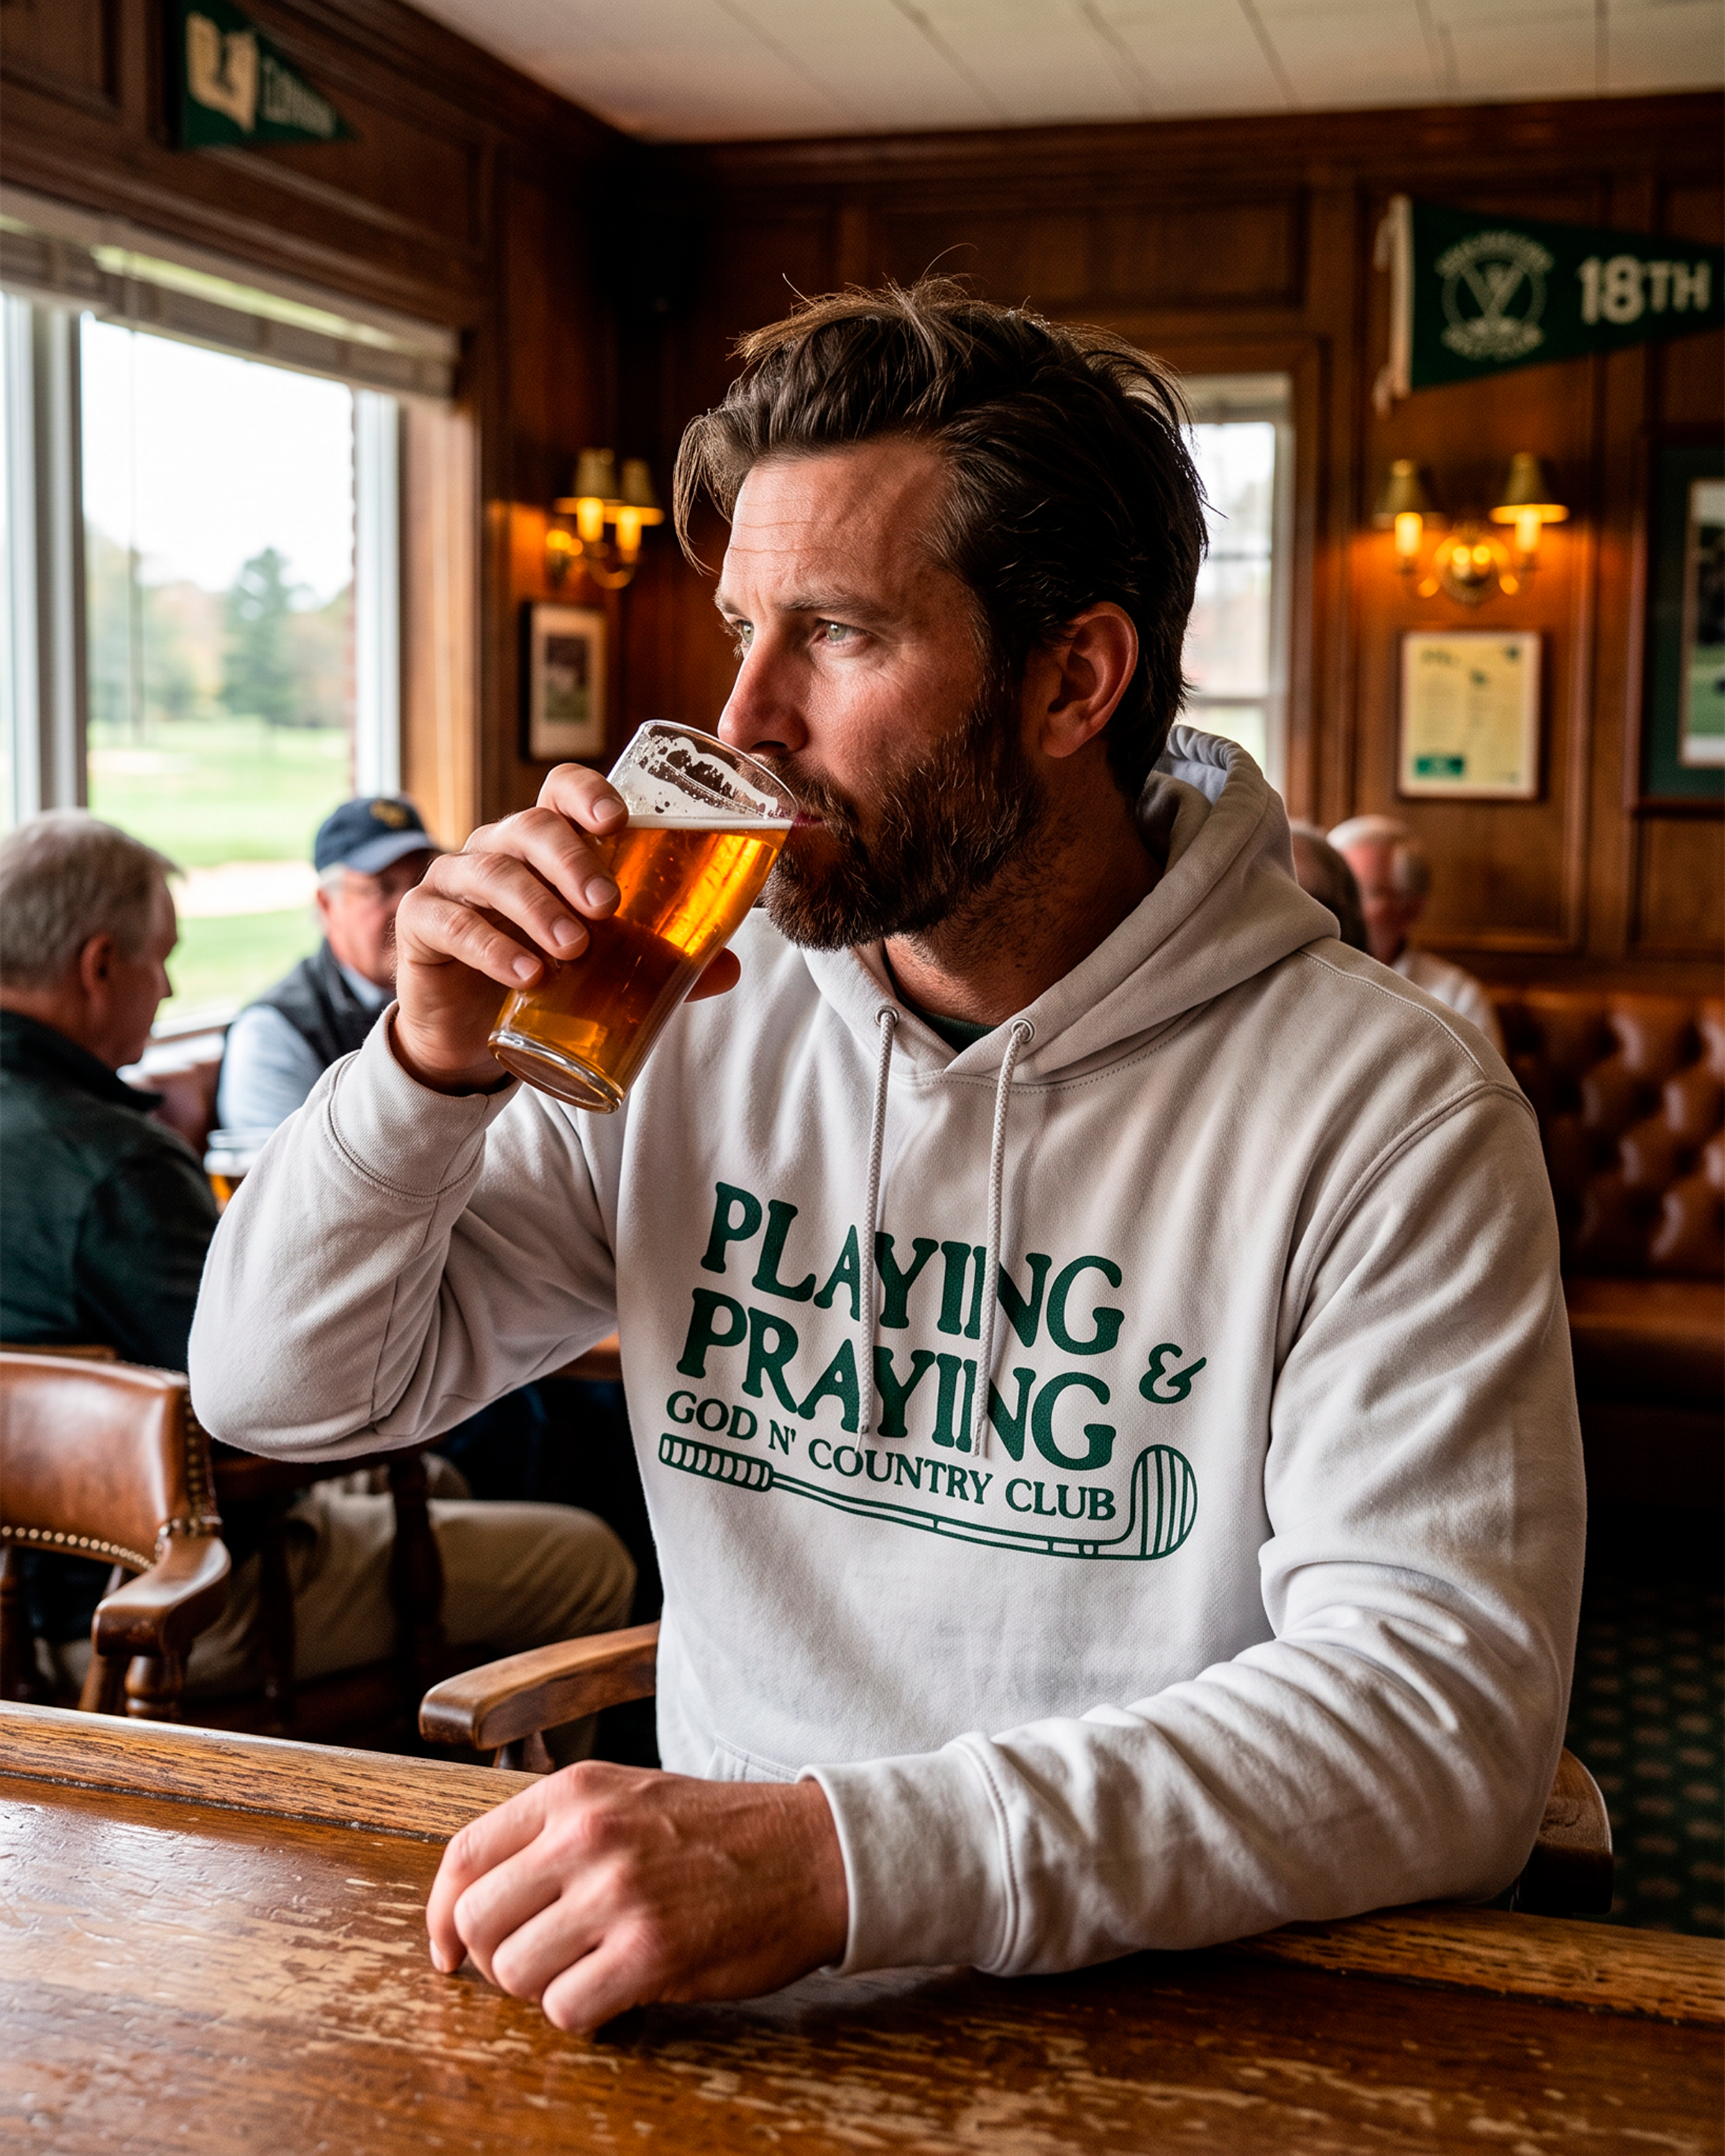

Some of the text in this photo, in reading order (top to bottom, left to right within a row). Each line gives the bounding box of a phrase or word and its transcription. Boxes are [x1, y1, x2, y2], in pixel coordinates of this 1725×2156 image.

[1578, 254, 1711, 326] 18TH
[700, 1181, 1125, 1355] PLAYING
[676, 1287, 1117, 1471] PRAYING
[1138, 1342, 1207, 1404] &
[666, 1390, 1117, 1521] GOD N' COUNTRY CLUB
